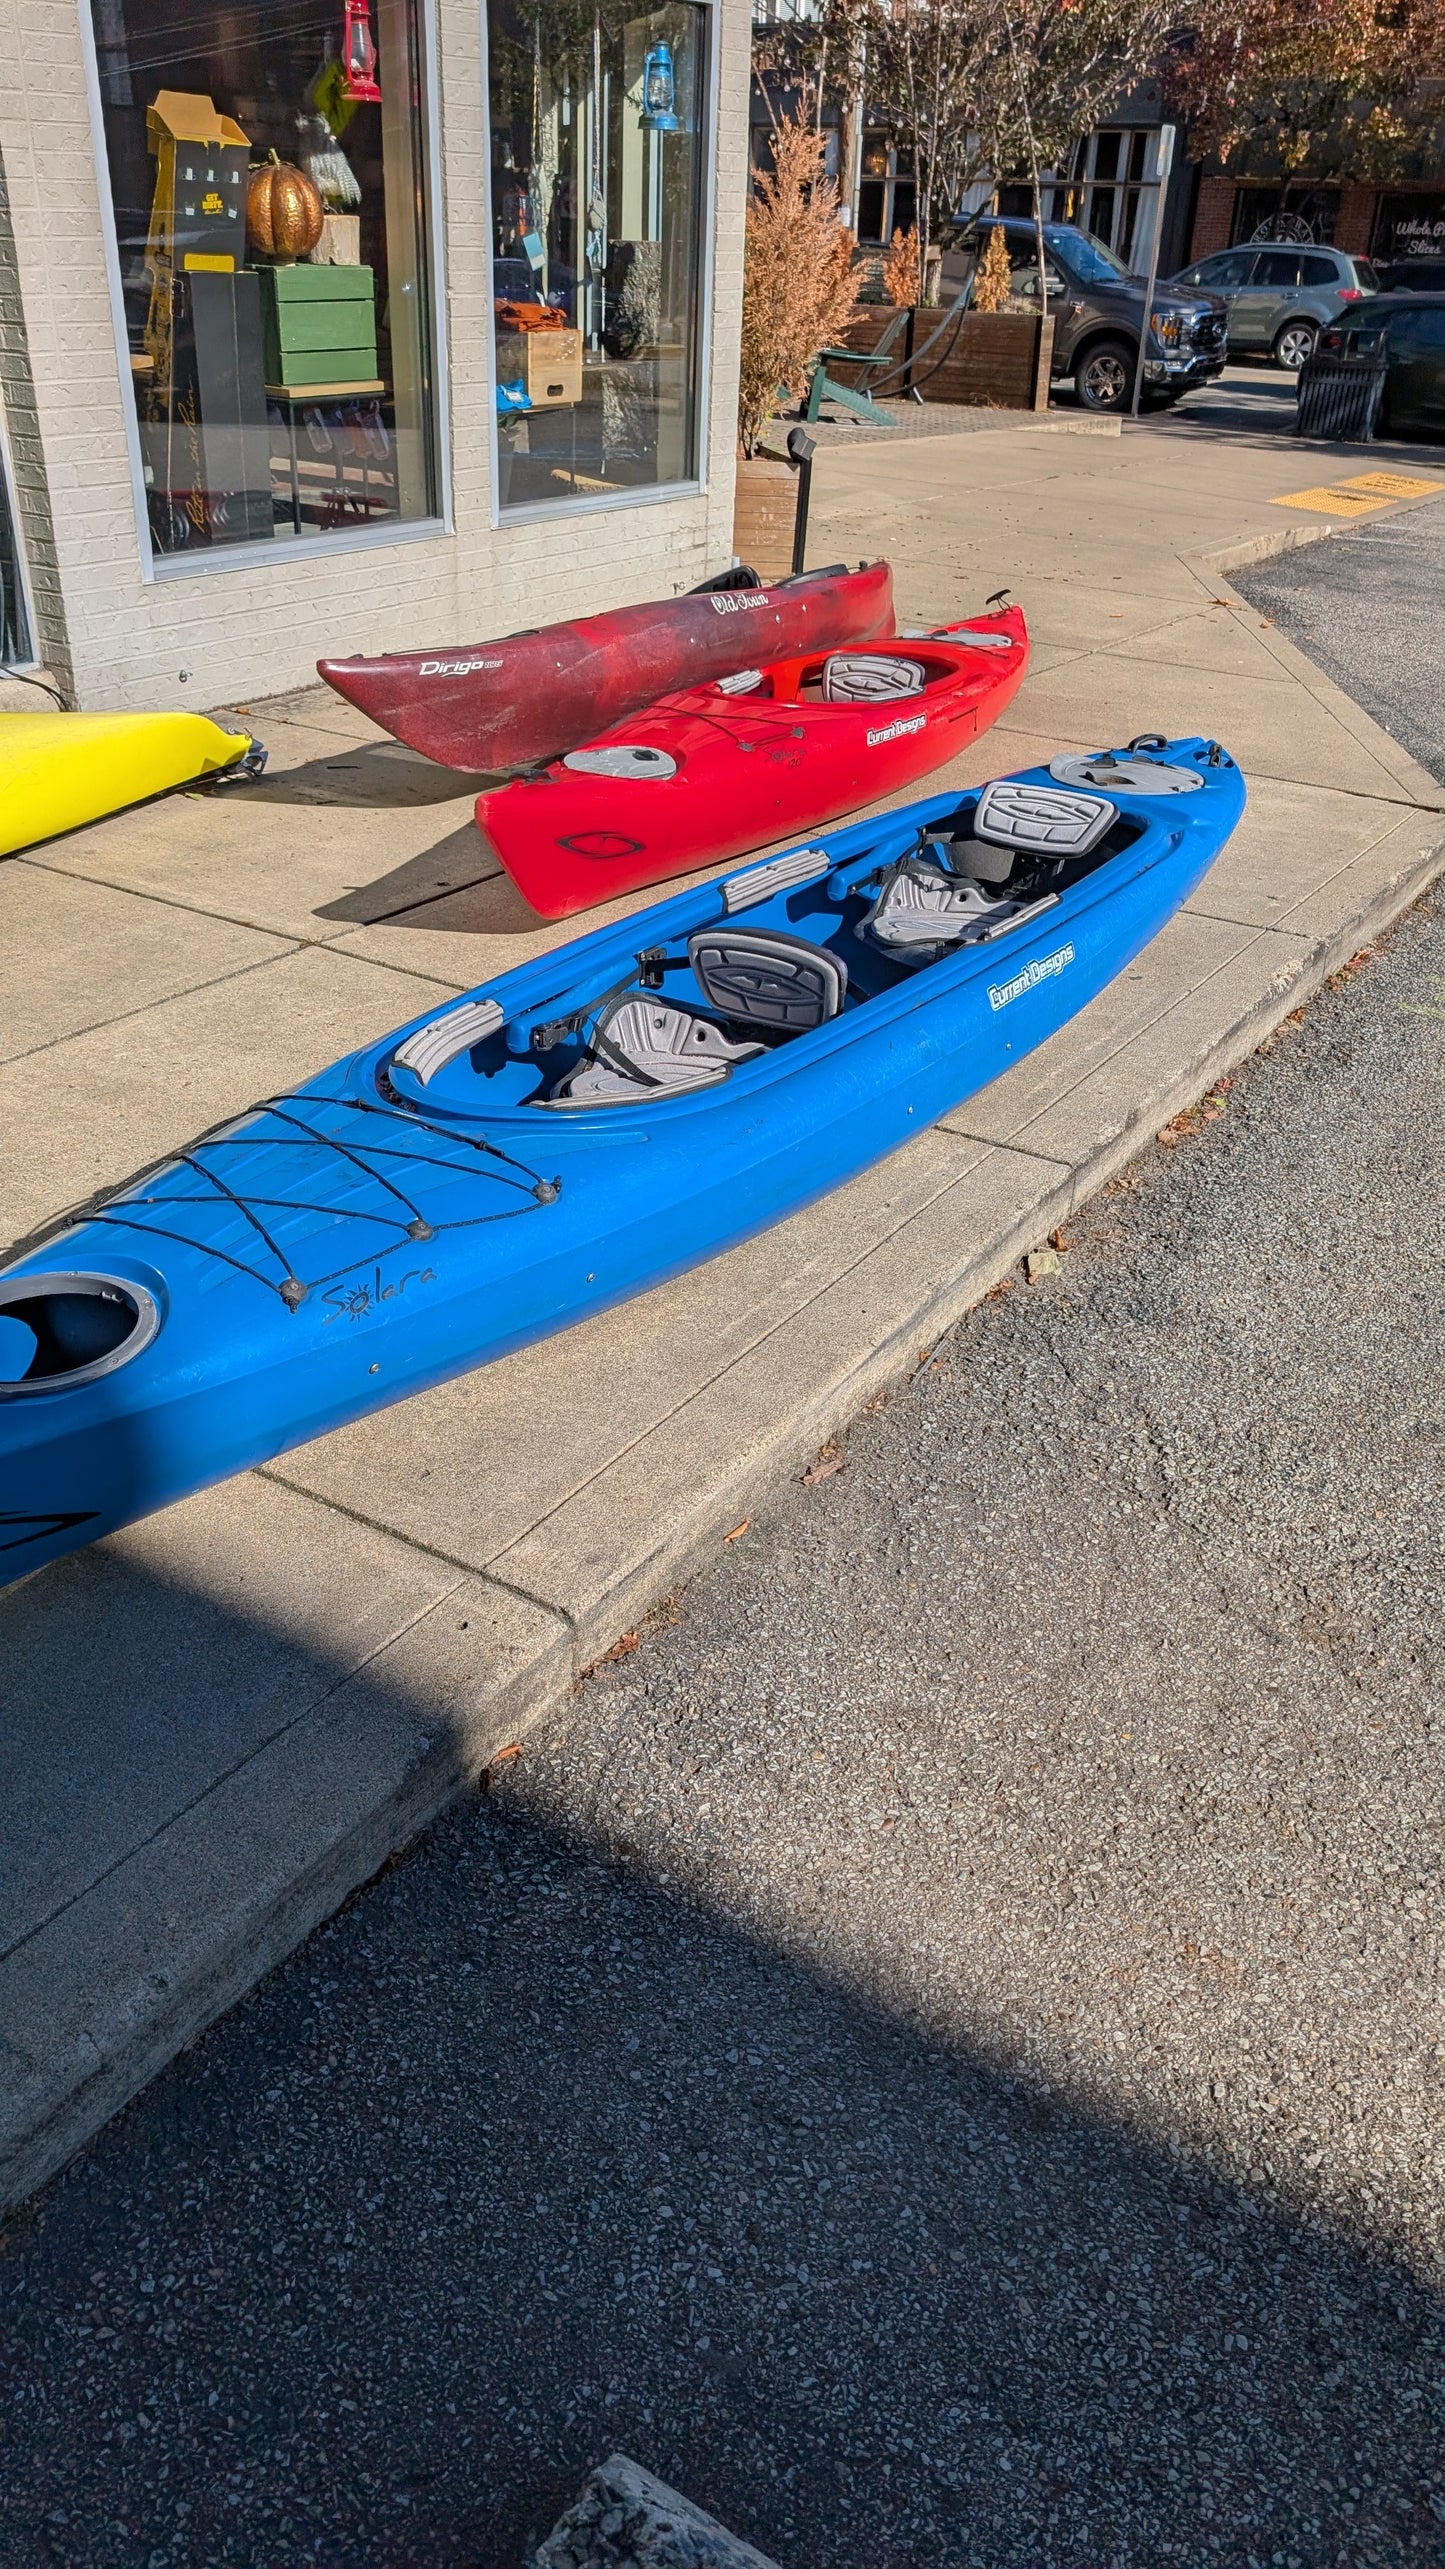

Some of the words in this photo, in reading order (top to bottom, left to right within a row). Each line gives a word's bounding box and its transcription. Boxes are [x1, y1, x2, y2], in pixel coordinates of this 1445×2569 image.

[1396, 219, 1432, 235] Whole
[1408, 240, 1441, 254] Slices
[178, 375, 197, 434] Rain
[188, 436, 200, 465] the
[186, 485, 206, 534] Rite
[711, 594, 738, 615] Old
[734, 591, 769, 610] Town
[419, 661, 484, 678] Dirigo
[867, 721, 896, 746] Current
[895, 713, 927, 735] Designs
[987, 966, 1031, 1010] Current
[1028, 941, 1075, 985] Designs
[321, 1266, 437, 1327] Solara
